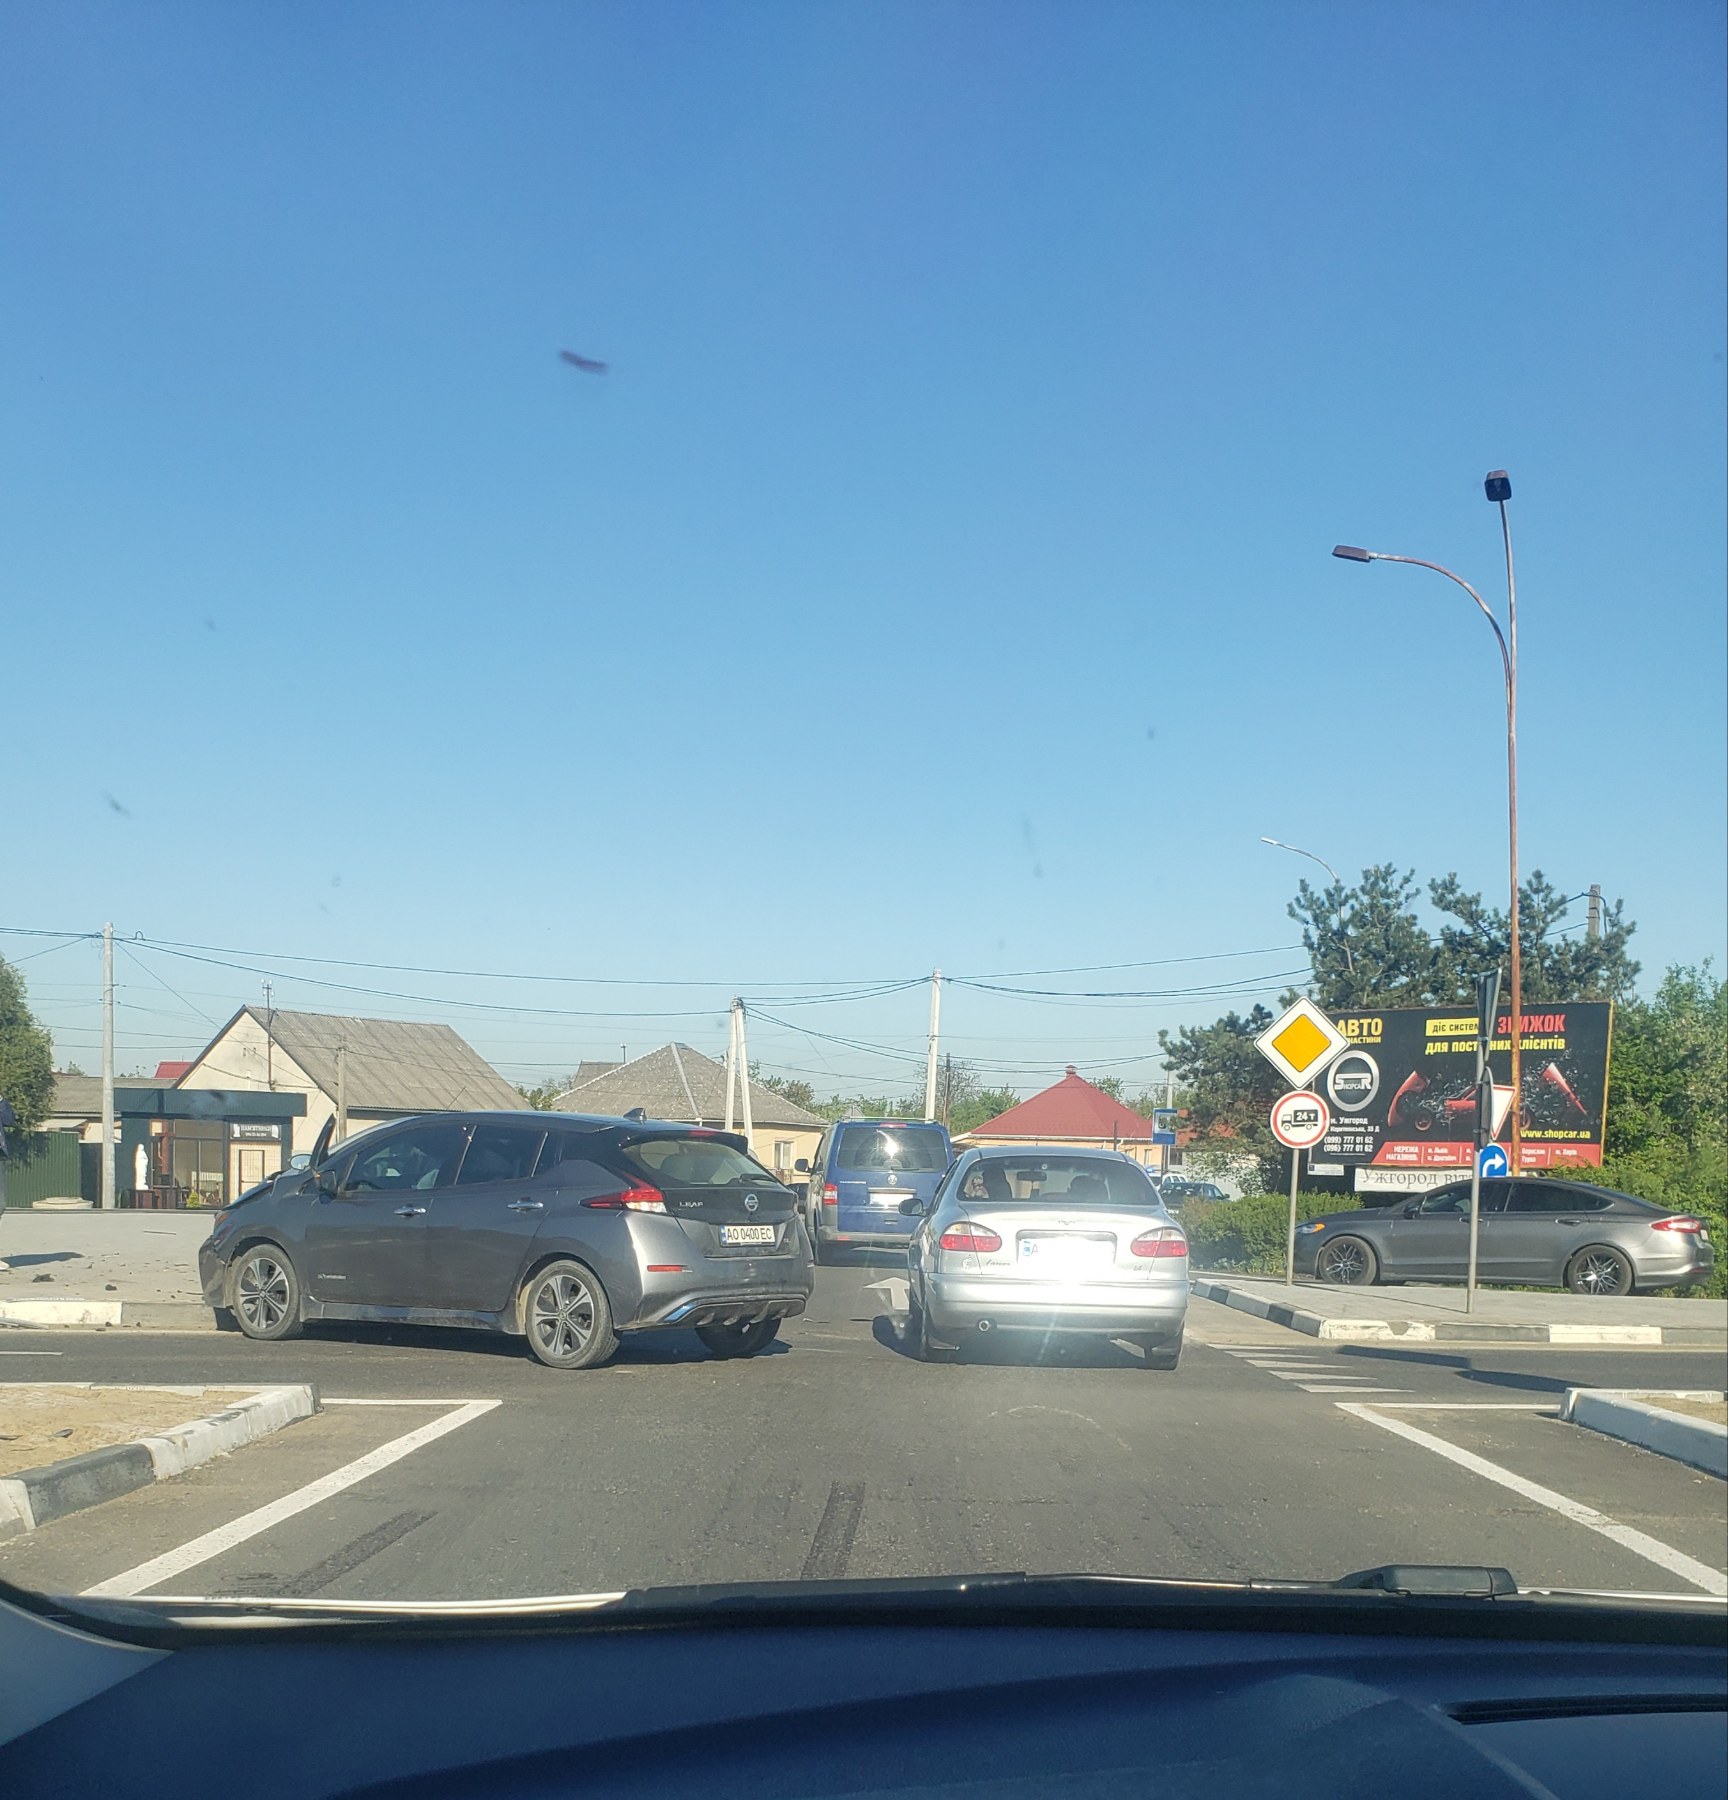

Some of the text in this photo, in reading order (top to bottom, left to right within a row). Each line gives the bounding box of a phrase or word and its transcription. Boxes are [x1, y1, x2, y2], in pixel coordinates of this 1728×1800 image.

[1337, 1018, 1383, 1037] АВТО
[1432, 1022, 1446, 1034] діє
[1449, 1023, 1479, 1032] систем
[1425, 1042, 1448, 1055] для
[1451, 1040, 1512, 1053] постних
[1296, 1112, 1308, 1121] 24
[1339, 1117, 1368, 1125] Ужгород
[1520, 1129, 1591, 1139] www.shopcar.ua
[1343, 1136, 1355, 1144] 777
[1364, 1136, 1374, 1144] 62
[1343, 1144, 1354, 1152] 777
[1355, 1144, 1363, 1152] 01
[1364, 1144, 1373, 1152] 62
[1362, 1168, 1438, 1189] Ужгород
[727, 1227, 772, 1241] AO 0400 EC
